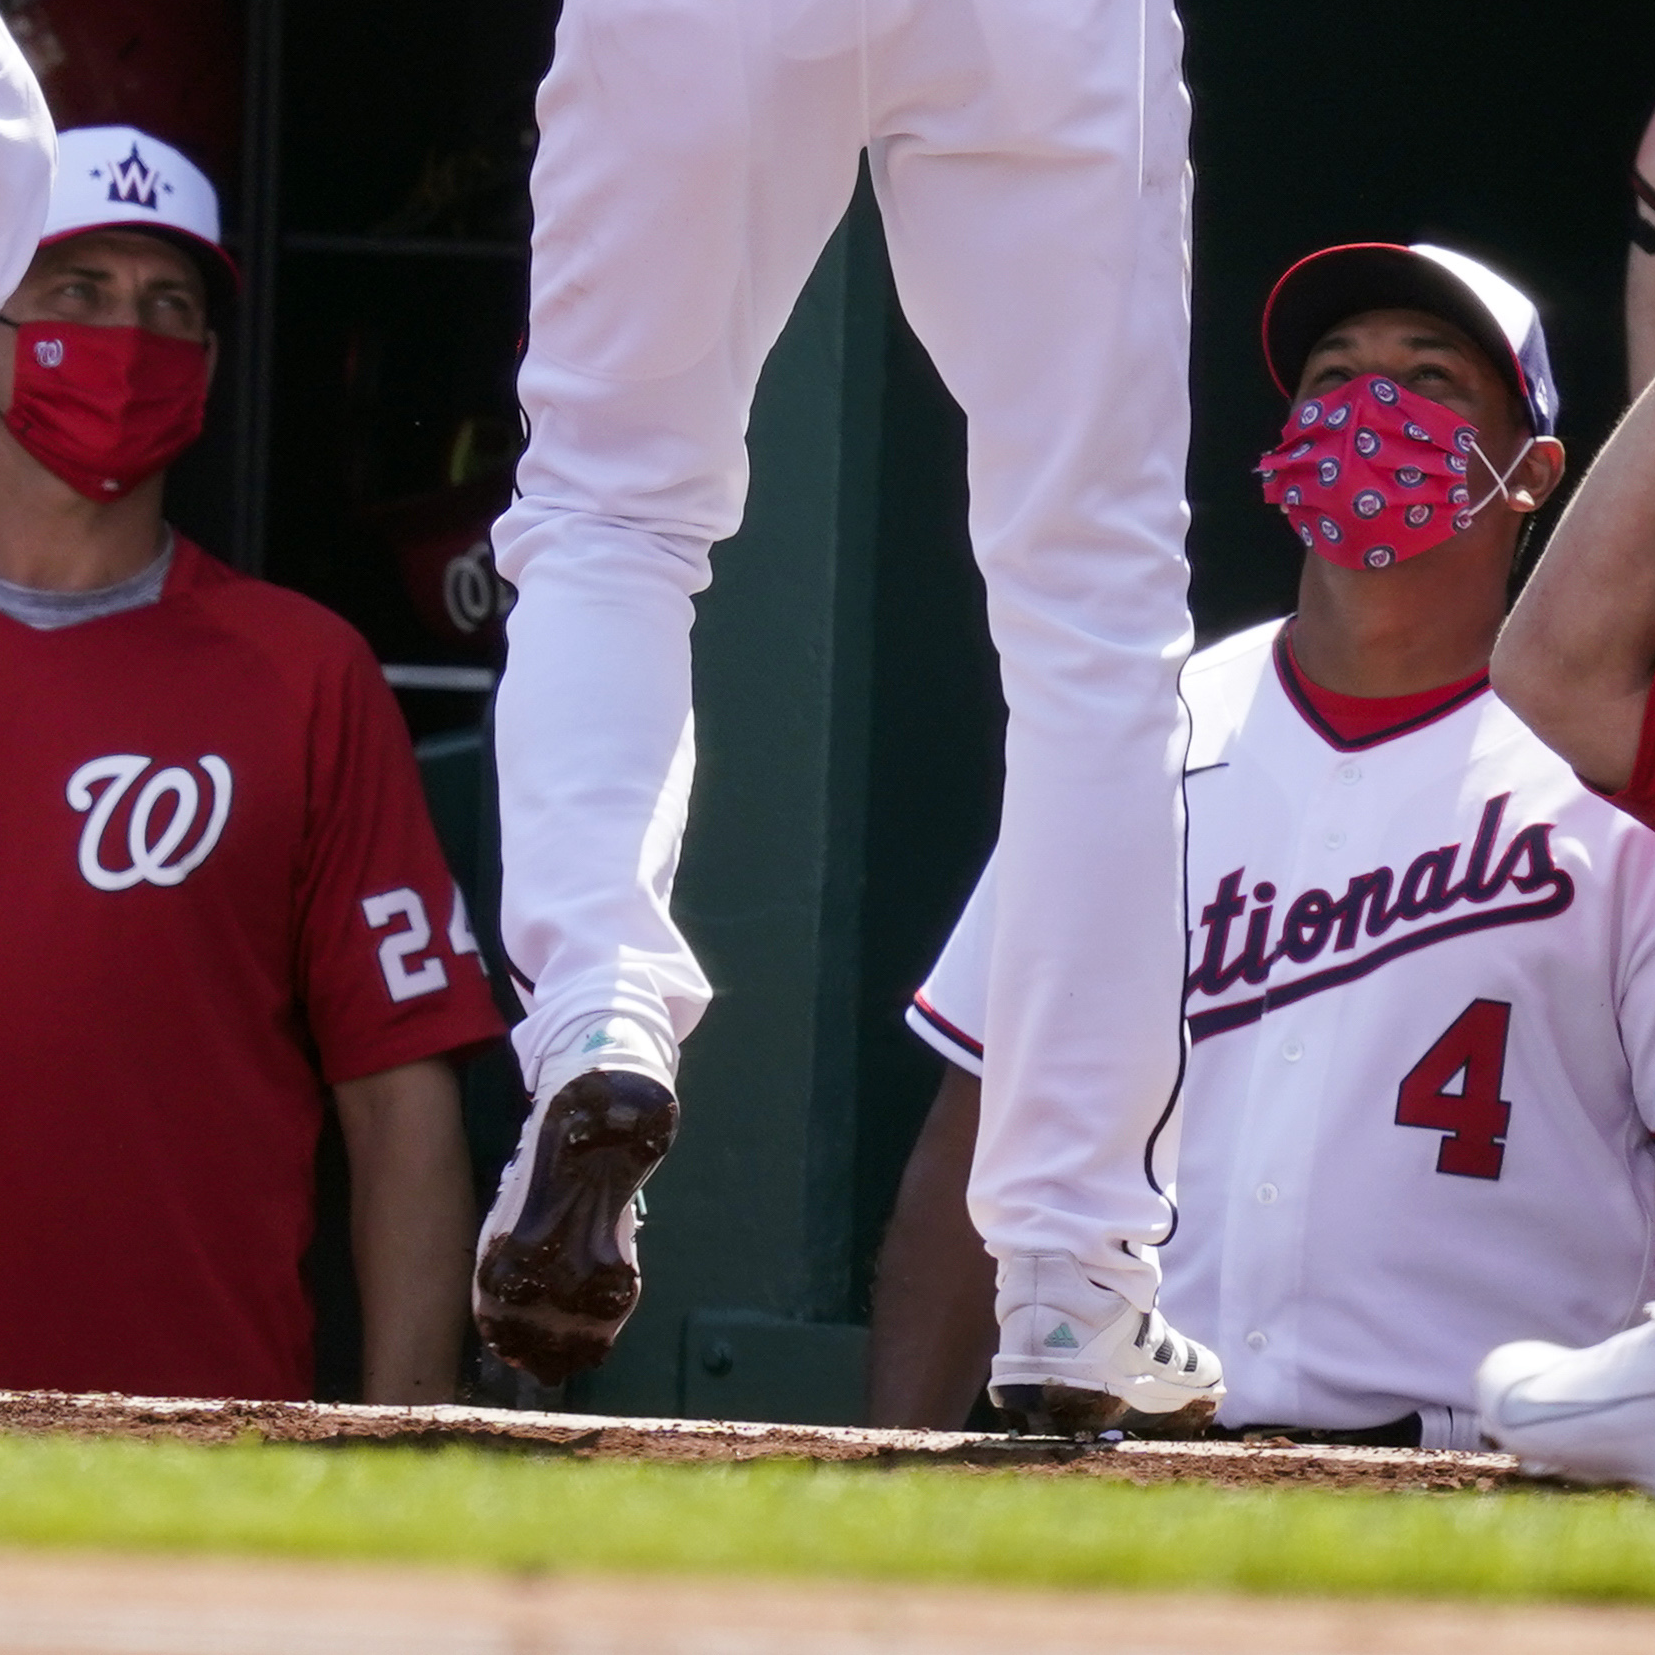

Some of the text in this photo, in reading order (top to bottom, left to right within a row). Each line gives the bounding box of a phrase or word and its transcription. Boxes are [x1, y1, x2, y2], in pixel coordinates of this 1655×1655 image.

[108, 161, 160, 204] W
[66, 753, 234, 892] W
[1186, 791, 1565, 996] tionals
[1394, 997, 1512, 1181] 4
